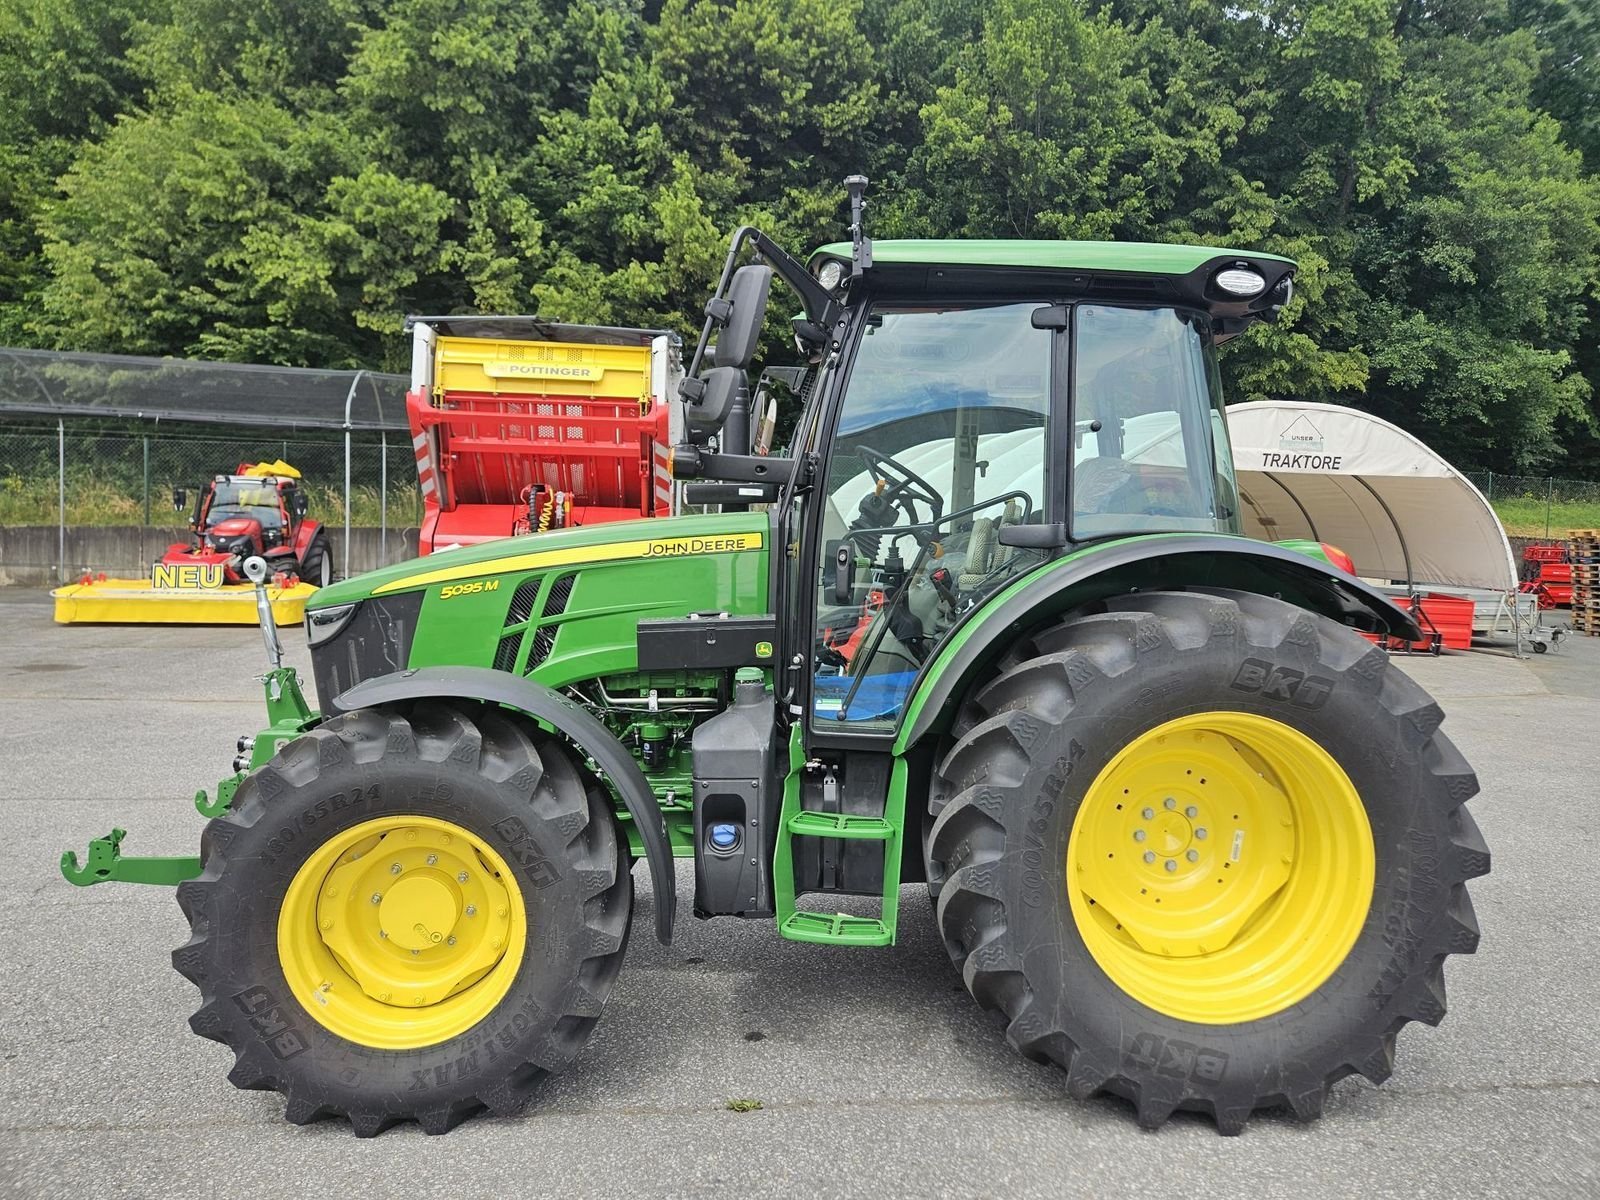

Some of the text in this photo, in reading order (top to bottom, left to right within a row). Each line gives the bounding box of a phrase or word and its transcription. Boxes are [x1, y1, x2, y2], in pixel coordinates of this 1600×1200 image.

[1262, 453, 1342, 470] TRAKTORE
[643, 539, 746, 556] JOHN DEERE
[152, 563, 224, 589] NEU
[440, 580, 499, 599] 5095 M
[1230, 658, 1335, 711] BKT
[492, 816, 562, 889] BKT
[231, 985, 309, 1060] BKT
[1120, 1032, 1230, 1086] BKT
